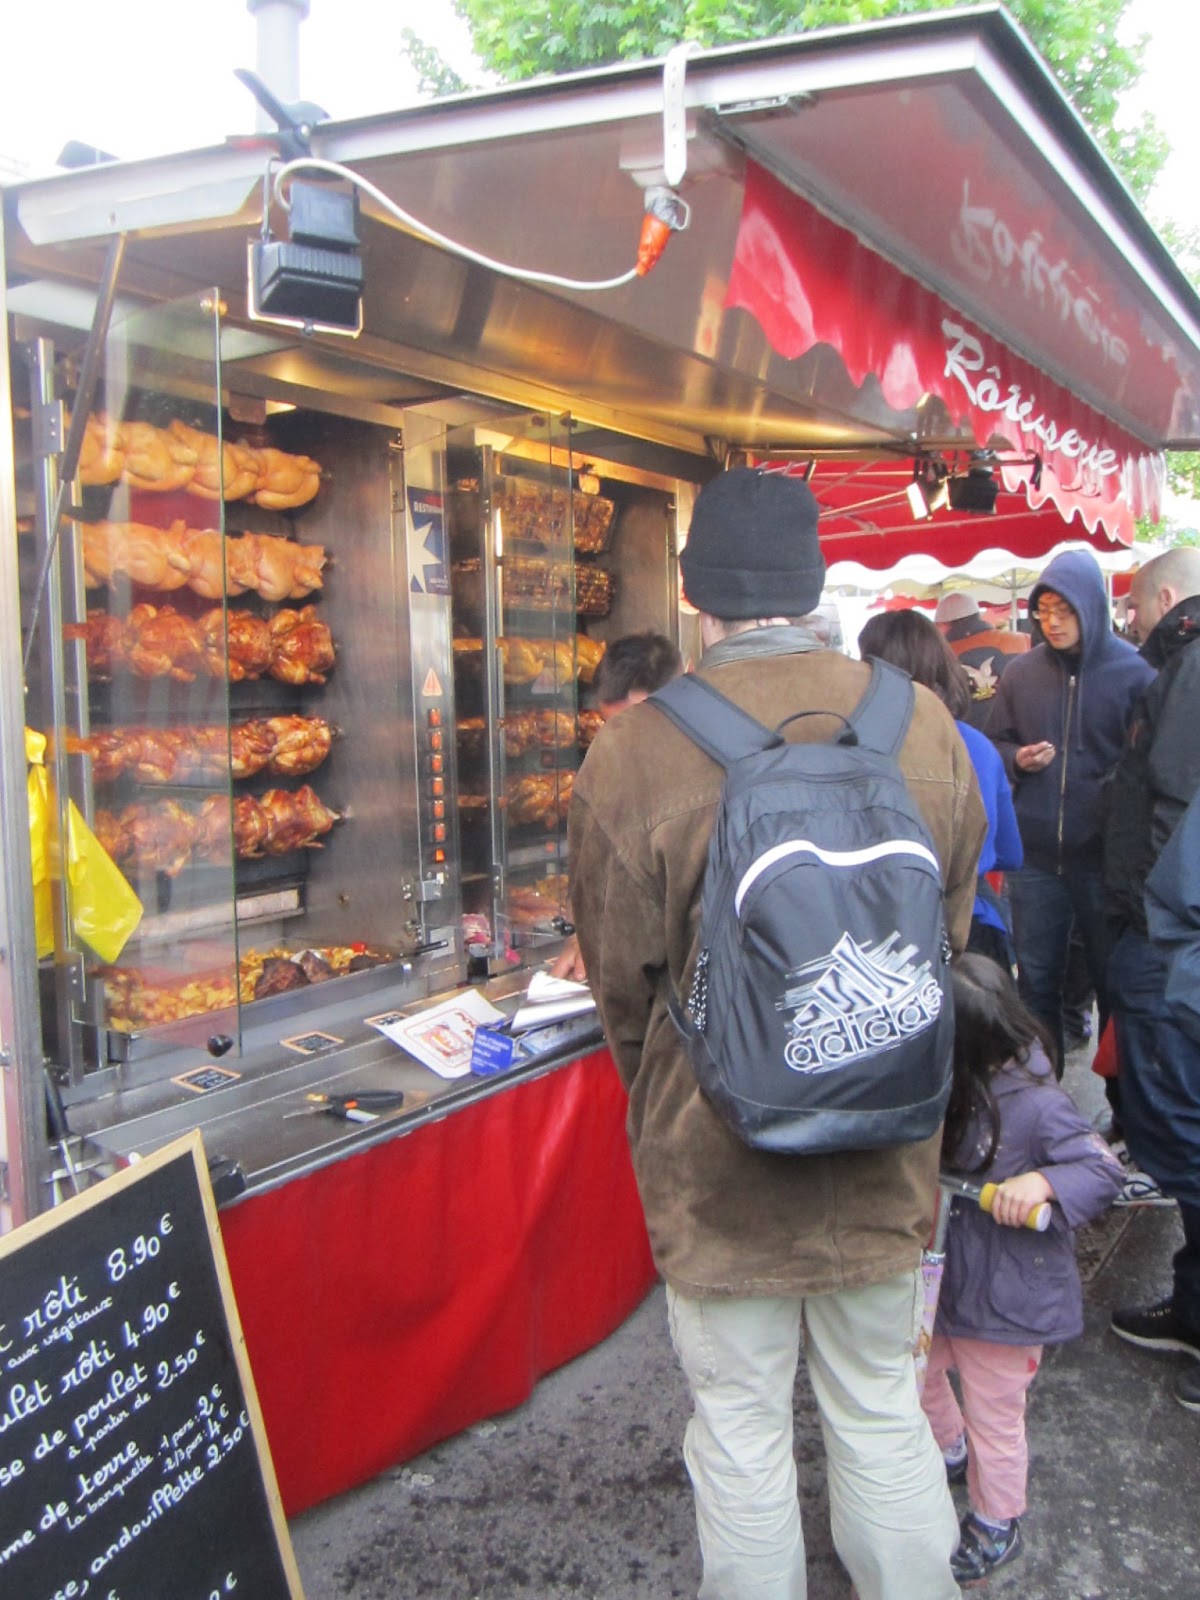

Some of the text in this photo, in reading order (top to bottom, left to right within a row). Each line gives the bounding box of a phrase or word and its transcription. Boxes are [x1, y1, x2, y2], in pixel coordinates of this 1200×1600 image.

[784, 979, 943, 1072] adidas
[8, 1343, 39, 1369] aux
[43, 1296, 113, 1346] végétaux
[24, 1275, 88, 1338] rôti
[61, 1340, 116, 1394] rôti
[134, 1392, 152, 1410] de
[35, 1429, 67, 1460] de
[74, 1362, 147, 1438] poulet
[0, 1440, 139, 1564] me de terre
[91, 1465, 205, 1574] andouillette
